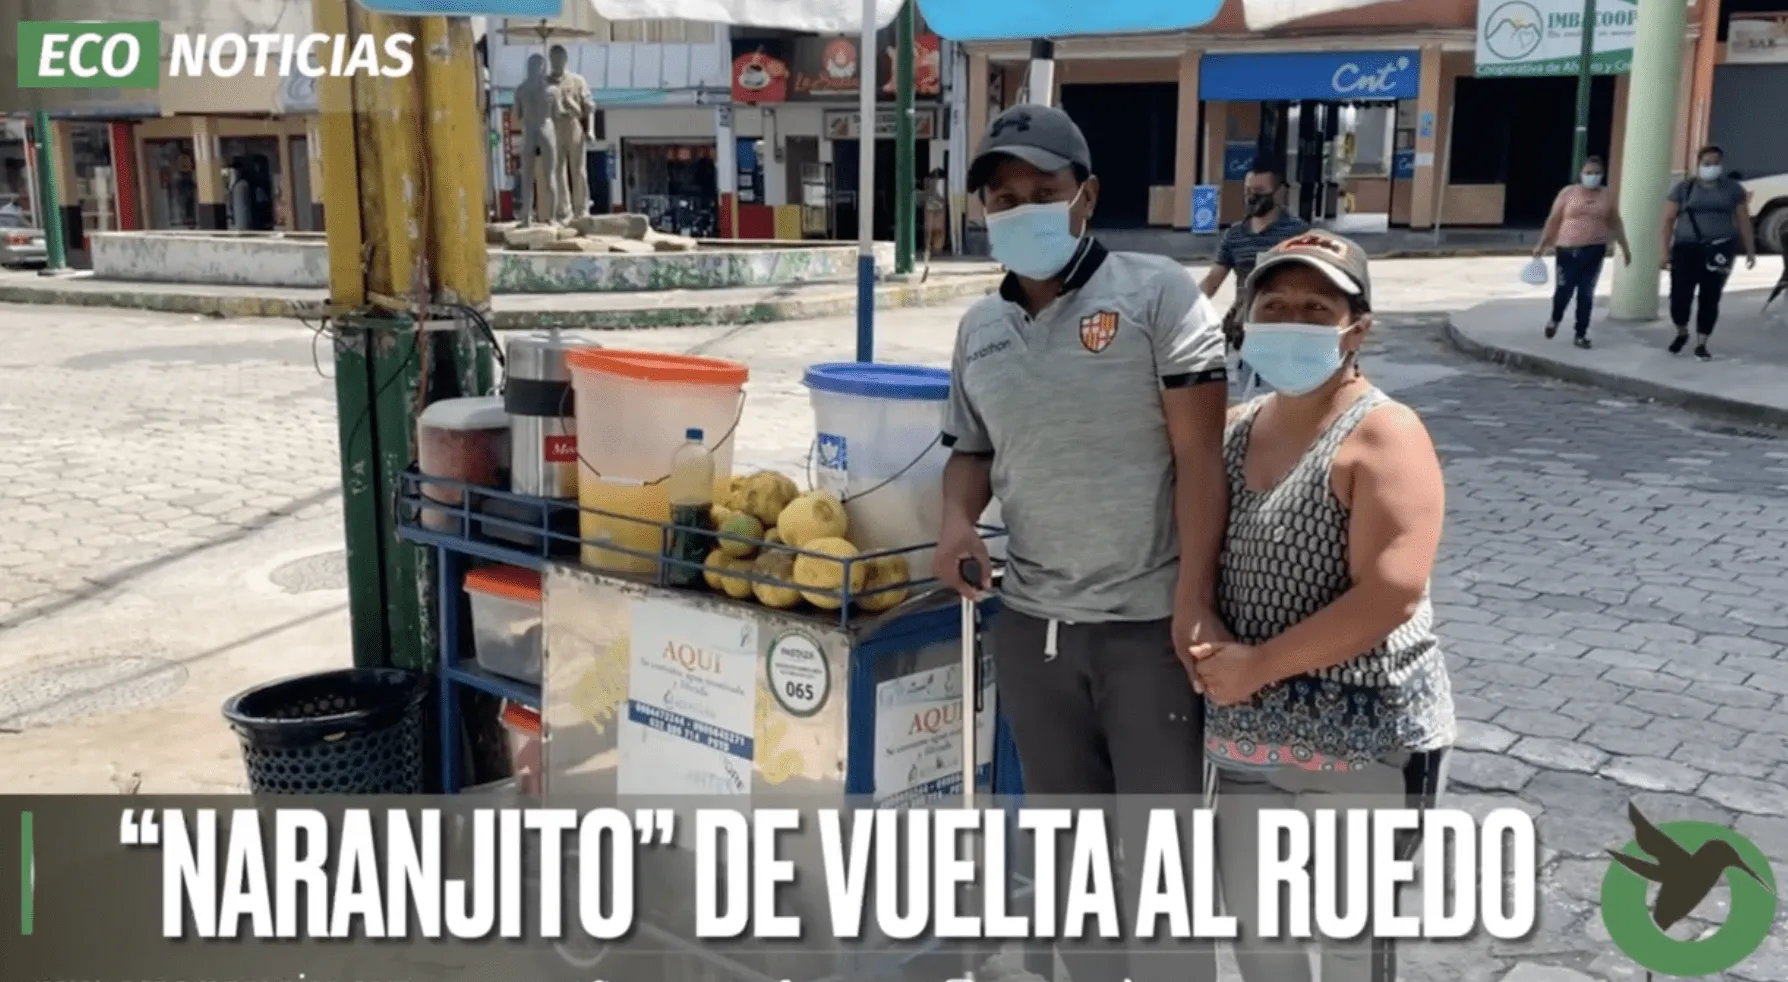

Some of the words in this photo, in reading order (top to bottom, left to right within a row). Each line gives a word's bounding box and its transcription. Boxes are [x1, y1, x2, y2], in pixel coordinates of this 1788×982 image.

[1547, 9, 1638, 29] IMBCOOP
[1331, 60, 1398, 93] Cnt
[1545, 62, 1561, 74] de
[662, 640, 723, 674] AQUI
[785, 680, 814, 701] 065
